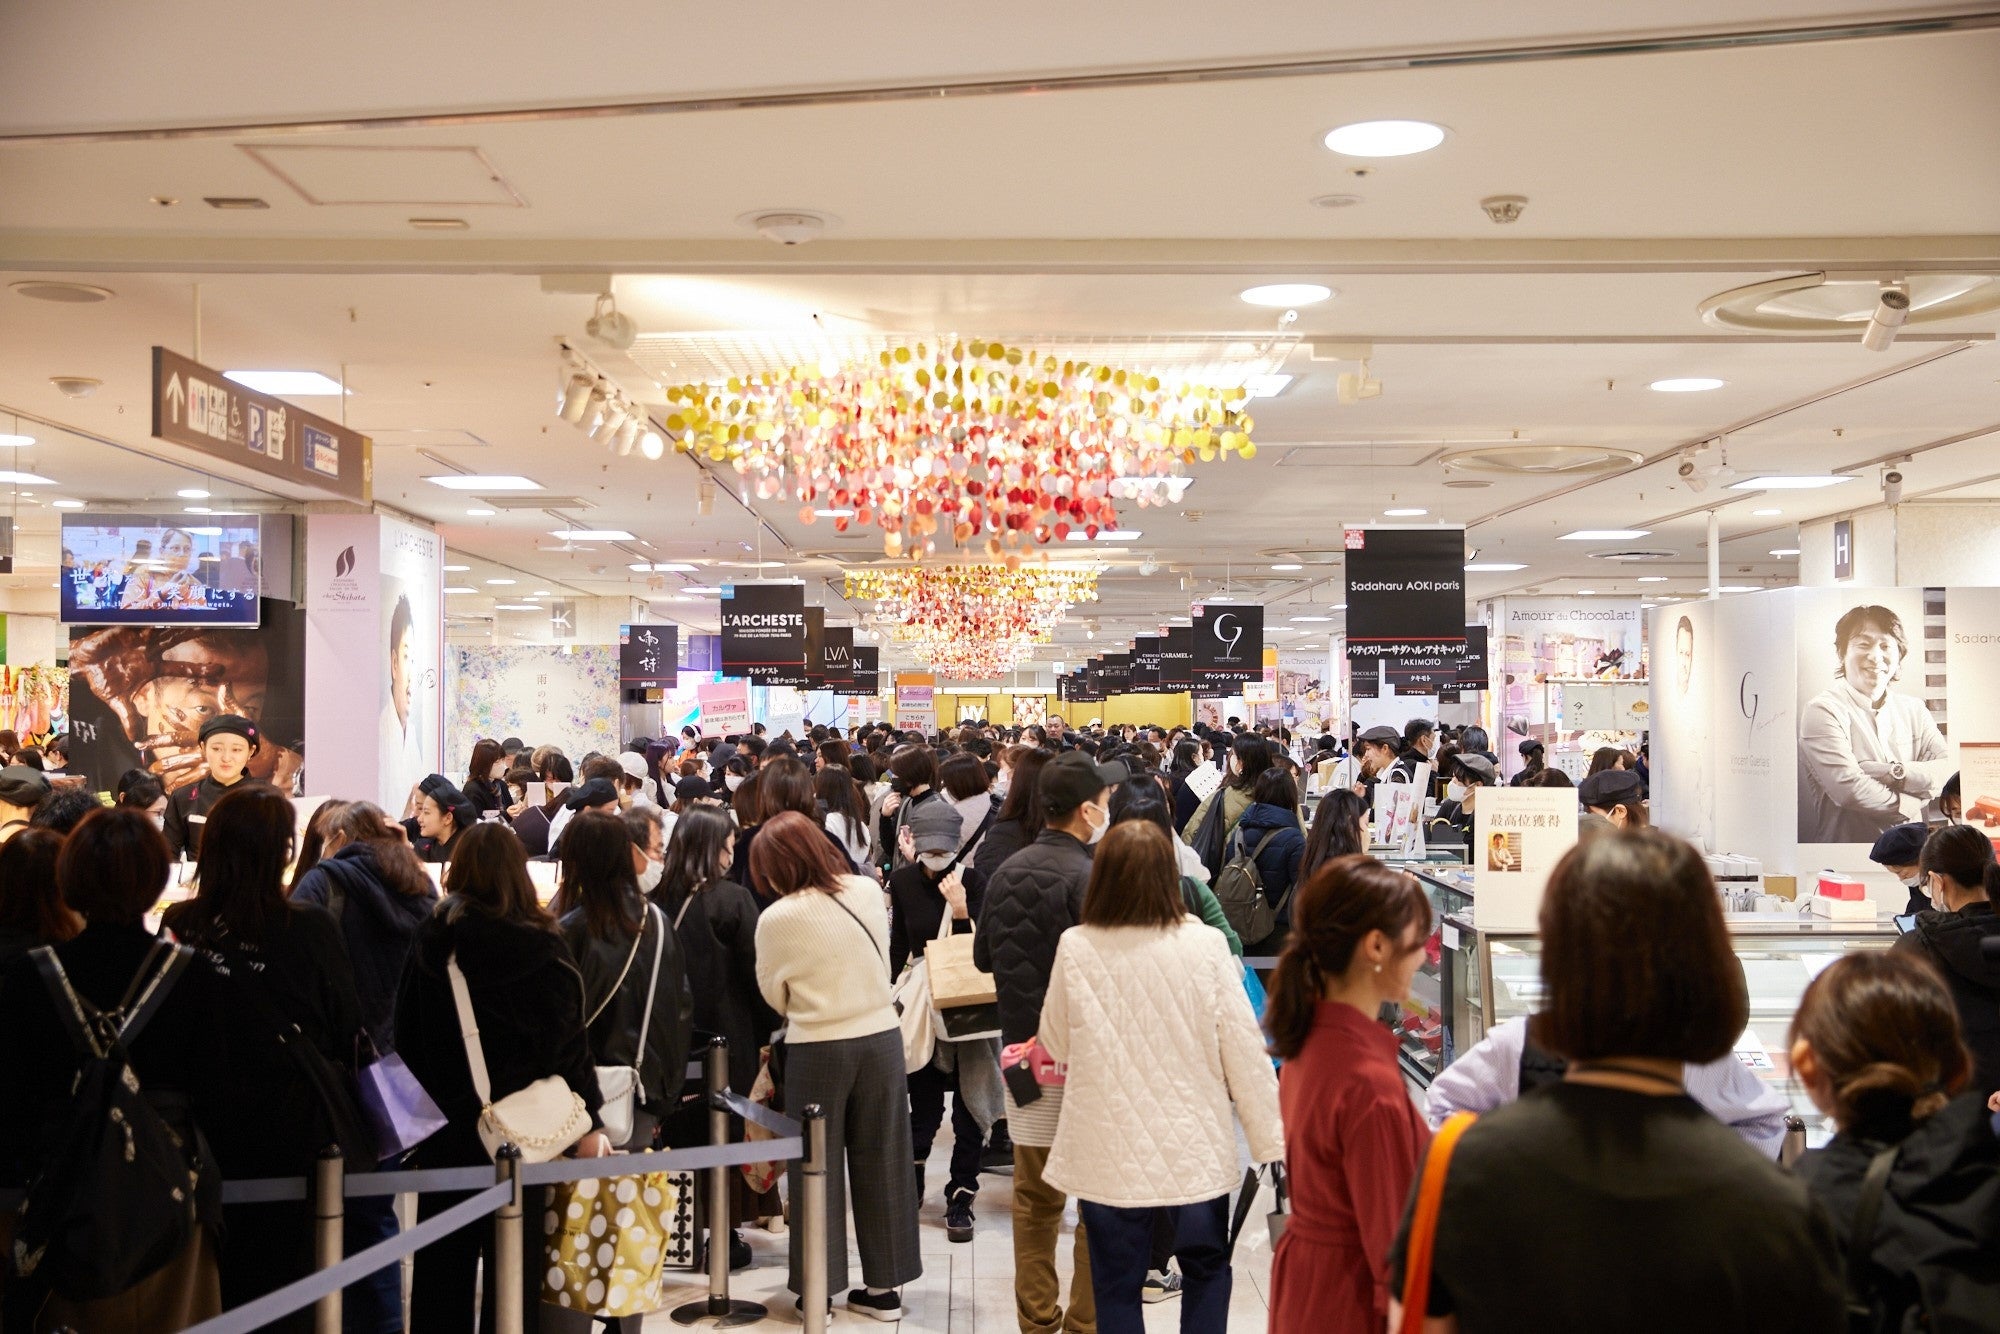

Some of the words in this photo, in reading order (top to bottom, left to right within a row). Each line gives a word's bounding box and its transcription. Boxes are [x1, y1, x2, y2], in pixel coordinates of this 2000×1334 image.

[1836, 533, 1849, 566] H
[1350, 581, 1403, 592] Sadaharu
[1405, 581, 1433, 591] AOKI
[1434, 580, 1460, 592] paris
[721, 614, 804, 627] L'ARCHESTE
[1511, 610, 1556, 621] Amour
[1556, 612, 1569, 621] du
[1569, 610, 1636, 621] Chocolat!
[1400, 658, 1442, 666] TAKIMOTO
[748, 667, 779, 675] ラルケスト
[1204, 672, 1232, 680] ヴァンサン
[1232, 672, 1251, 680] ゲルレ
[536, 673, 549, 715] 雨の詩
[711, 703, 738, 712] カルヴァ
[1490, 813, 1562, 828] 最高位獲得
